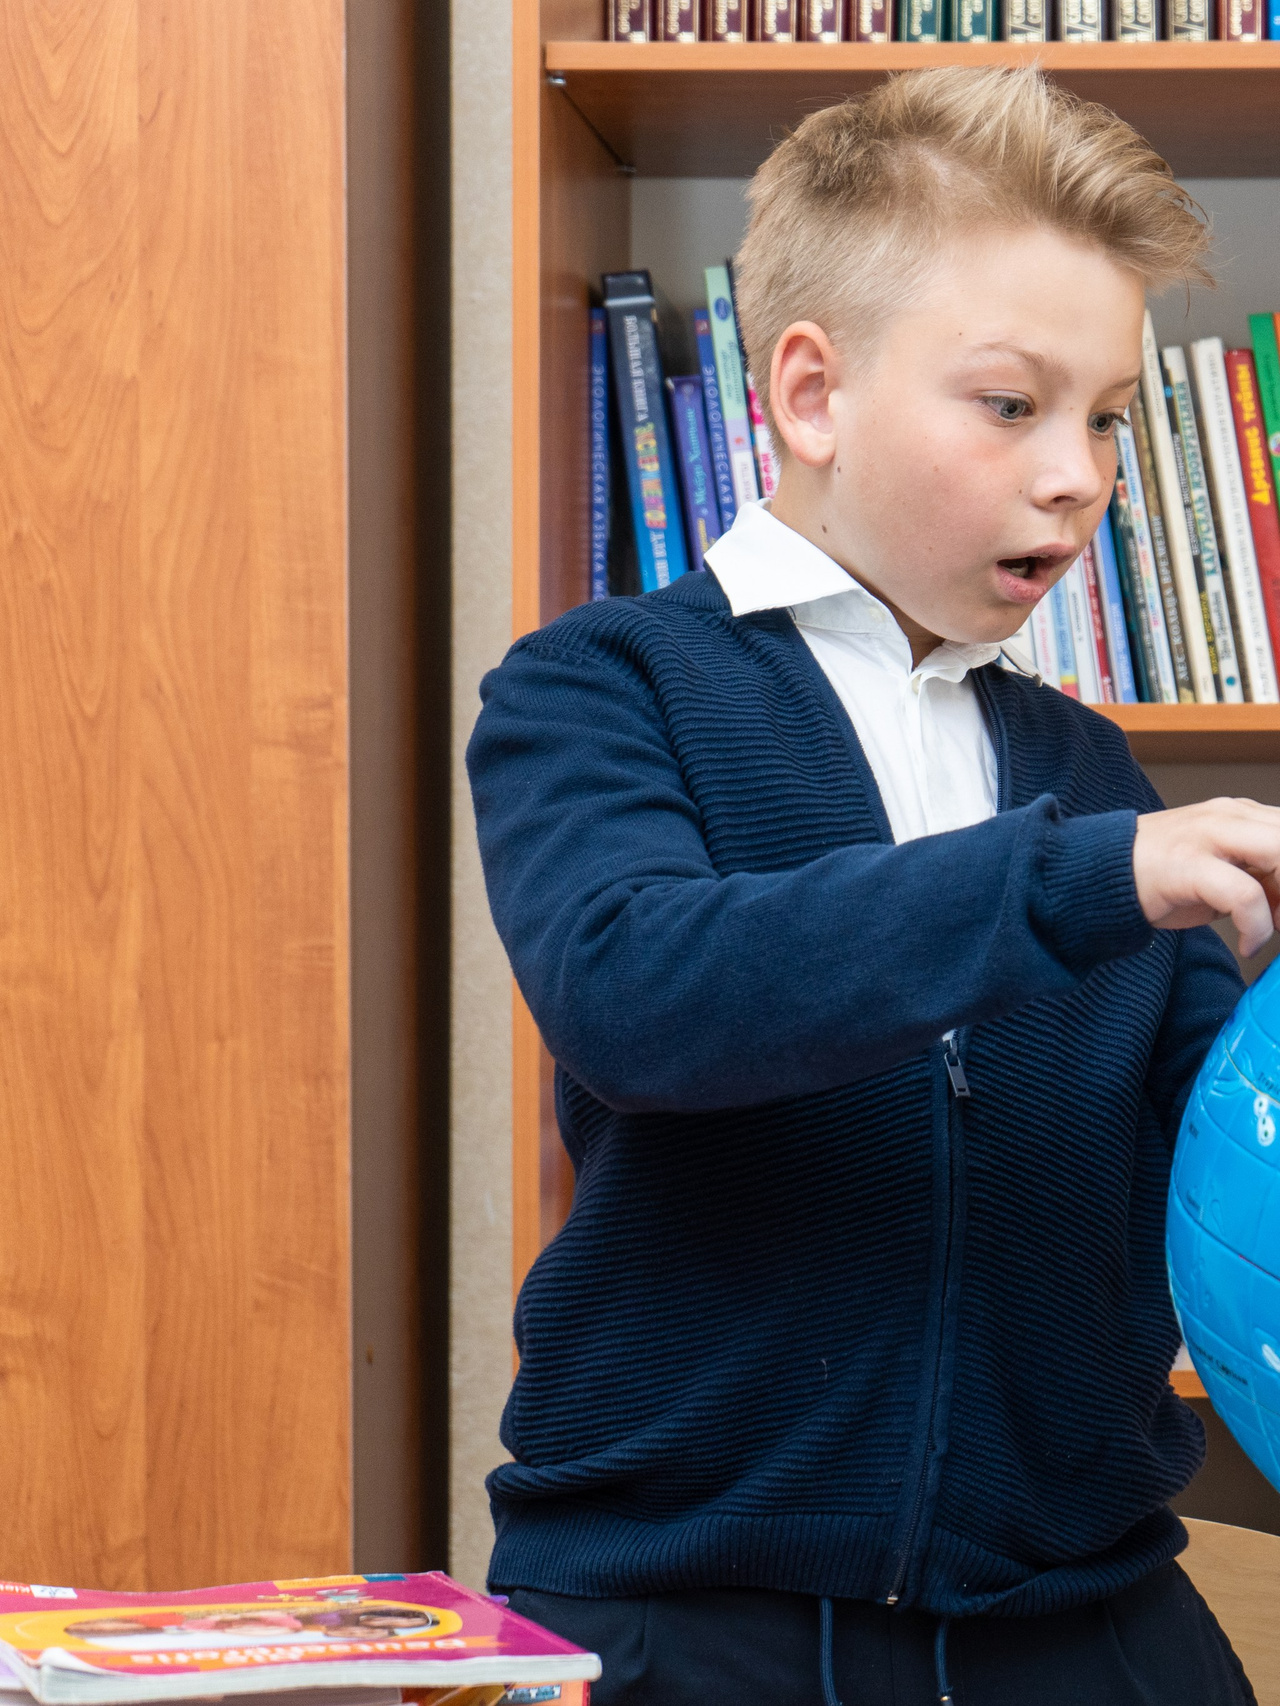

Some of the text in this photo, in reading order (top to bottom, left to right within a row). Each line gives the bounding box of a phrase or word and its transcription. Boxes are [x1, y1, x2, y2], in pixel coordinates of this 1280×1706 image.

[592, 364, 604, 503] ЭКОЛОГИЧЕСКАЯ
[702, 363, 732, 503] ЭКОЛОГИЧЕСКАЯ
[1230, 362, 1257, 423] тайны
[632, 422, 668, 531] ЭКСПЕРИМЕНТОВ
[1239, 424, 1273, 506] Древние
[593, 509, 605, 571] АЗБУКА
[1150, 514, 1173, 584] ВРЕМЕНИ
[1191, 493, 1220, 577] КАРУСЕЛЬ
[1162, 585, 1185, 645] КОЛЬЦА
